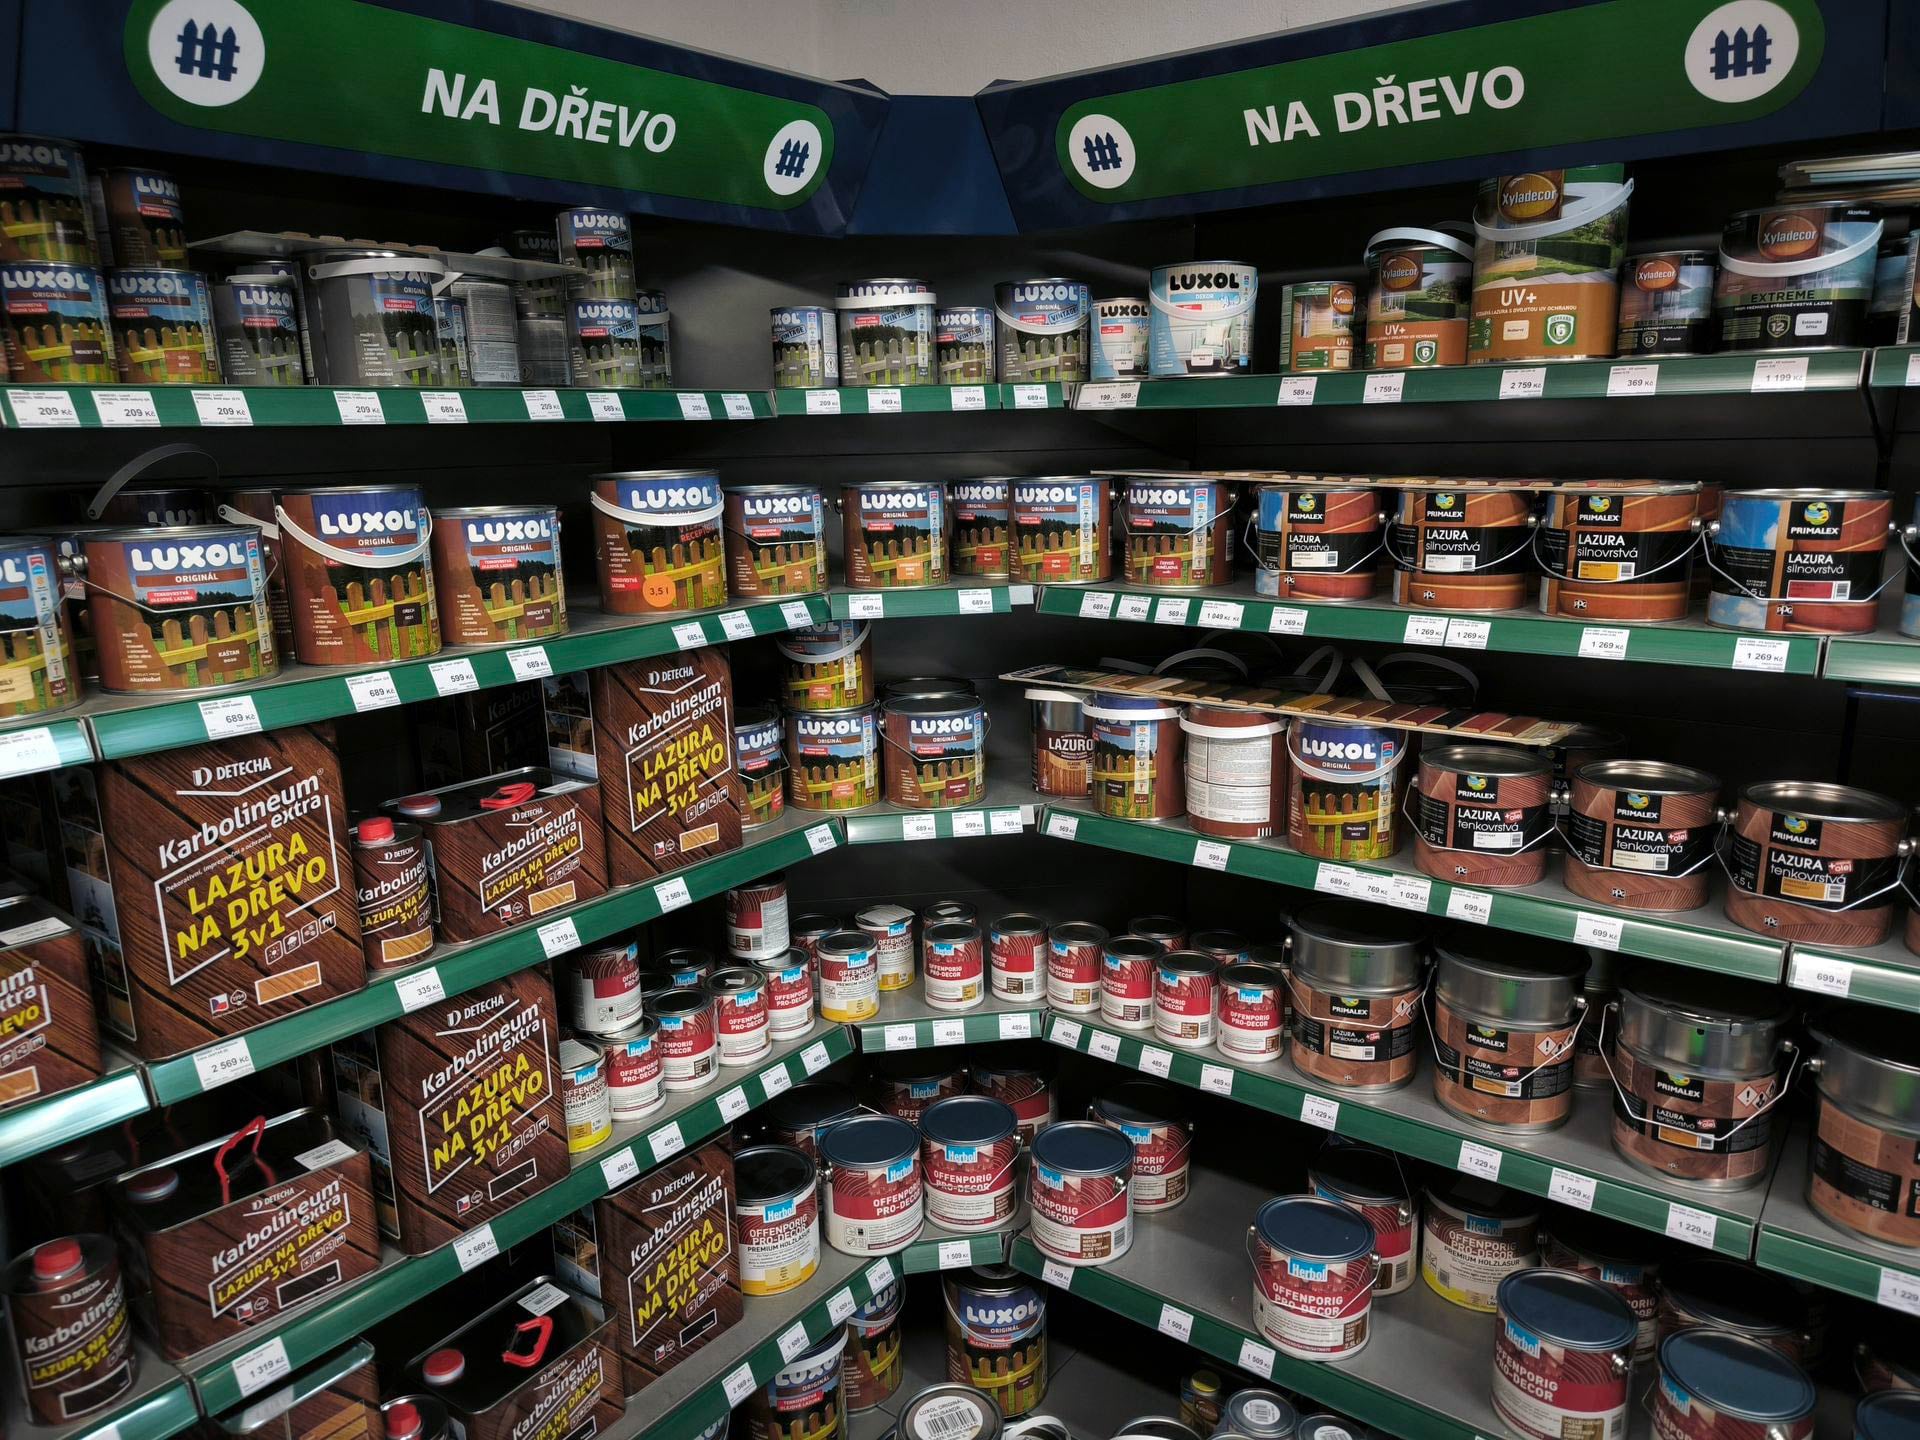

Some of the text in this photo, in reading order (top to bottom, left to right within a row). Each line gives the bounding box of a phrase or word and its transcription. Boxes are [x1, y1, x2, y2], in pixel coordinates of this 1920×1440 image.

[421, 68, 676, 154] NA DŘEVO
[1244, 65, 1525, 146] NA DŘEVO
[1502, 191, 1557, 206] Xyladecor
[574, 215, 626, 230] LUXOL
[1762, 230, 1817, 244] Xyladecor
[3, 270, 90, 290] LUXOL
[1169, 272, 1240, 291] LUXOL
[1381, 267, 1419, 281] Xyladecor
[1638, 269, 1677, 281] Xyladecor
[110, 276, 189, 295] LUXOL
[1014, 284, 1078, 304] LUXOL
[1500, 288, 1537, 307] UV+
[1750, 289, 1815, 303] EXTREME
[578, 304, 632, 319] LUXOL
[882, 308, 915, 326] VINTAGE
[1100, 304, 1148, 317] LUXOL
[1385, 324, 1406, 336] UV+
[1518, 381, 1532, 389] 759
[1627, 379, 1644, 387] 369
[39, 407, 73, 416] 209 Kč
[125, 408, 156, 417] 209 Kč
[217, 407, 234, 416] 209
[631, 486, 712, 509] LUXOL
[861, 491, 926, 509] LUXOL
[951, 485, 1002, 501] LUXOL
[1014, 487, 1077, 504] LUXOL
[1130, 488, 1191, 506] LUXOL
[744, 495, 812, 514] LUXOL
[1031, 504, 1056, 512] ORIGINÁL
[320, 510, 417, 535] LUXOL
[1289, 512, 1323, 520] PRIMALEX
[1427, 510, 1465, 519] PRIMALEX
[1579, 513, 1620, 522] PRIMALEX
[467, 519, 552, 542] LUXOL
[1289, 534, 1321, 544] LAZURA
[1426, 529, 1469, 541] LAZURA
[1790, 526, 1840, 536] PRIMALEX
[358, 536, 395, 546] ORIGINÁL
[501, 543, 533, 553] ORIGINÁL
[1289, 542, 1330, 552] silnovrstvá
[1425, 540, 1480, 552] silnovrstvá
[1578, 534, 1626, 547] LAZURA
[131, 543, 246, 571] LUXOL
[1577, 546, 1638, 559] silnovrstvá
[1788, 554, 1834, 565] LAZURA
[175, 572, 219, 583] ORIGINÁL
[1786, 563, 1844, 575] silnovrstvá
[451, 674, 465, 682] 599
[662, 666, 694, 682] DETECHA
[370, 689, 385, 697] 689
[629, 682, 721, 745] Karbolineum
[691, 696, 722, 721] extra
[226, 713, 243, 723] 689
[911, 717, 973, 734] LUXOL
[797, 719, 859, 736] LUXOL
[643, 723, 714, 781] LAZURA
[1302, 737, 1377, 759] LUXOL
[216, 756, 272, 780] DETECHA
[1322, 760, 1352, 770] ORIGINÁL
[636, 742, 725, 813] NA DŘEVO
[667, 782, 699, 818] 3v1
[1458, 791, 1496, 801] PRIMALEX
[270, 794, 322, 829] extra
[1458, 809, 1501, 822] LAZURA
[1617, 808, 1658, 819] PRIMALEX
[159, 774, 320, 870] Karbolineum
[1457, 819, 1519, 832] tenkovrstvá
[482, 808, 576, 873] Karbolineum
[546, 821, 577, 845] extra
[1617, 827, 1664, 843] LAZURA
[1772, 830, 1817, 846] PRIMALEX
[1616, 839, 1683, 854] tenkovrstvá
[486, 834, 578, 900] LAZURA NA DŘEVO
[1770, 851, 1824, 872] LAZURA
[187, 832, 308, 915] LAZURA
[524, 870, 545, 890] 3v1
[1770, 864, 1847, 884] tenkovrstvá
[177, 915, 223, 959] NA
[228, 856, 327, 930] DŘEVO
[1464, 904, 1477, 912] 699
[233, 910, 286, 960] 3v1
[1592, 928, 1607, 937] 699
[1817, 973, 1834, 983] 699
[417, 987, 431, 996] 335
[463, 993, 505, 1020] DETECHA
[729, 1010, 766, 1027] OFFENPORIG
[1229, 1011, 1270, 1021] OFFENPORIG
[1231, 1018, 1268, 1027] PRO-DECOR
[731, 1018, 764, 1032] PRO-DECOR
[502, 1020, 541, 1054] extra
[421, 1002, 540, 1098] Karbolineum
[221, 1058, 238, 1069] 569
[439, 1052, 531, 1134] LAZURA
[1657, 1082, 1700, 1099] PRIMALEX
[432, 1070, 544, 1172] NA DŘEVO
[472, 1121, 511, 1166] 3v1
[948, 1149, 977, 1163] Herbol
[889, 1161, 914, 1182] Herbol
[933, 1170, 992, 1186] OFFENPORIG
[872, 1182, 921, 1208] OFFENPORIG
[876, 1190, 921, 1217] PRO-DECOR
[299, 1192, 342, 1228] extra
[767, 1204, 796, 1221] Herbol
[212, 1177, 341, 1275] Karbolineum
[630, 1176, 724, 1267] Karbolineum
[1468, 1221, 1502, 1236] Herbol
[1448, 1231, 1517, 1252] OFFENPORIG
[217, 1209, 344, 1304] LAZURA NA DŘEVO
[1444, 1244, 1521, 1267] PREMIUM HOLZLASUR
[270, 1257, 299, 1282] 3v1
[1292, 1264, 1328, 1282] Herbol
[1272, 1281, 1344, 1306] OFFENPORIG
[966, 1299, 1038, 1326] LUXOL
[990, 1324, 1020, 1334] ORIGINÁL
